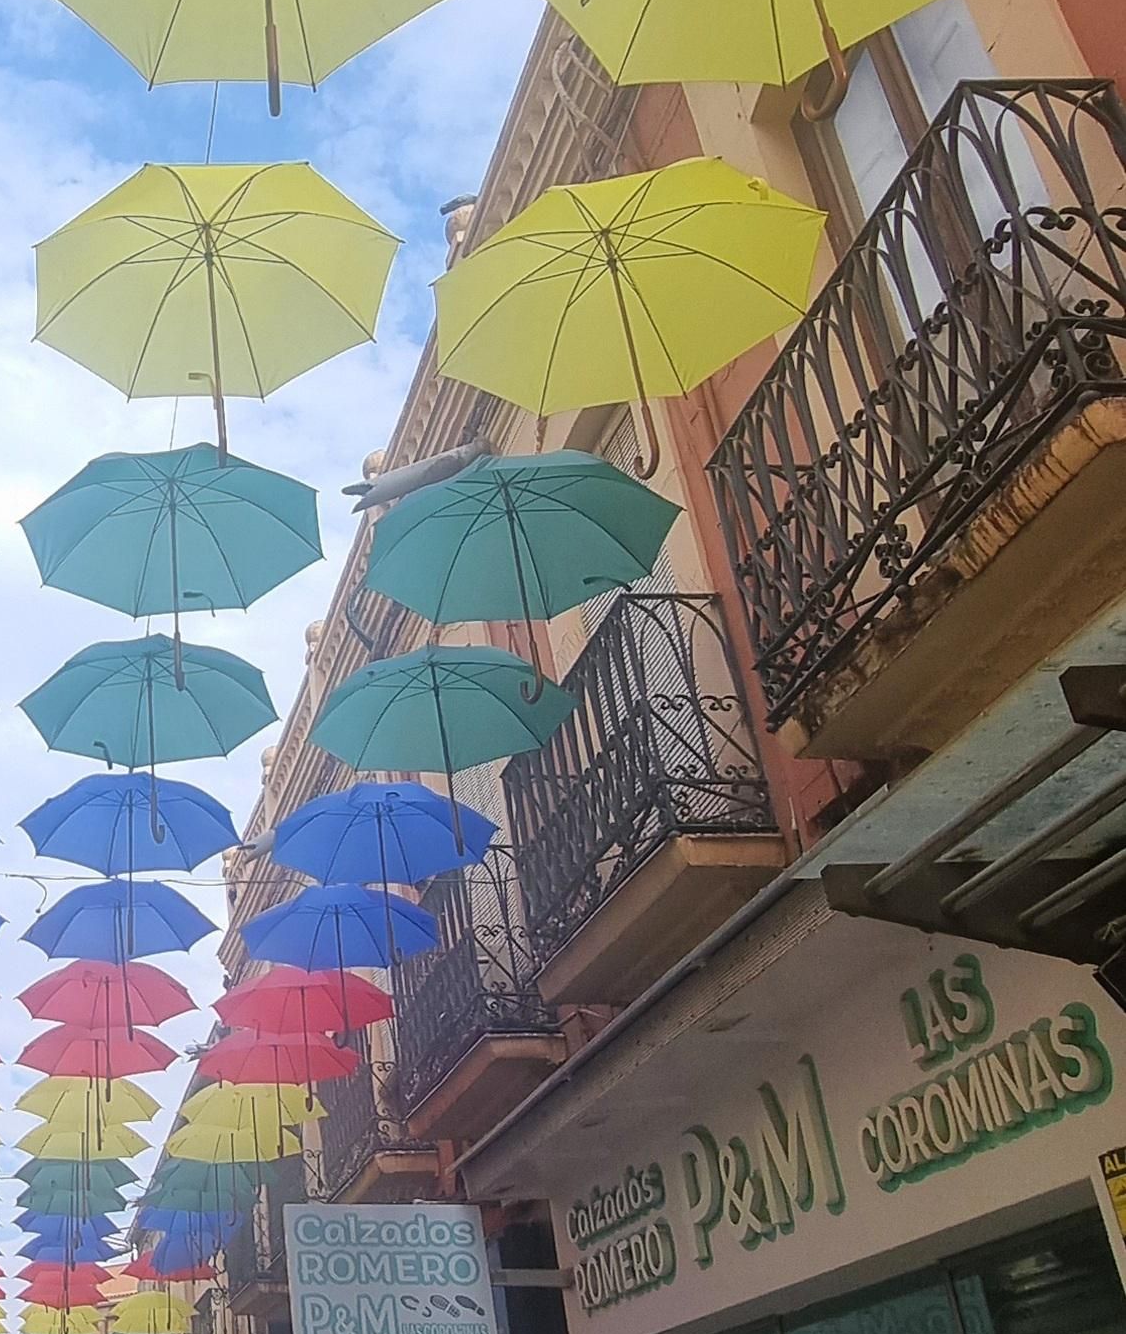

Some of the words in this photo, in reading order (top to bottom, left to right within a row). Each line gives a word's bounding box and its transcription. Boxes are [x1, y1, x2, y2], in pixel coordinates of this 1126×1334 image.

[901, 955, 993, 1068] LAS
[859, 1005, 1110, 1188] COROMINAS
[682, 1054, 846, 1269] P&M
[1104, 1153, 1126, 1175] AL
[295, 1213, 474, 1246] Calzados
[566, 1164, 663, 1247] Calzados
[298, 1250, 480, 1285] ROMERO
[575, 1220, 673, 1309] ROMERO
